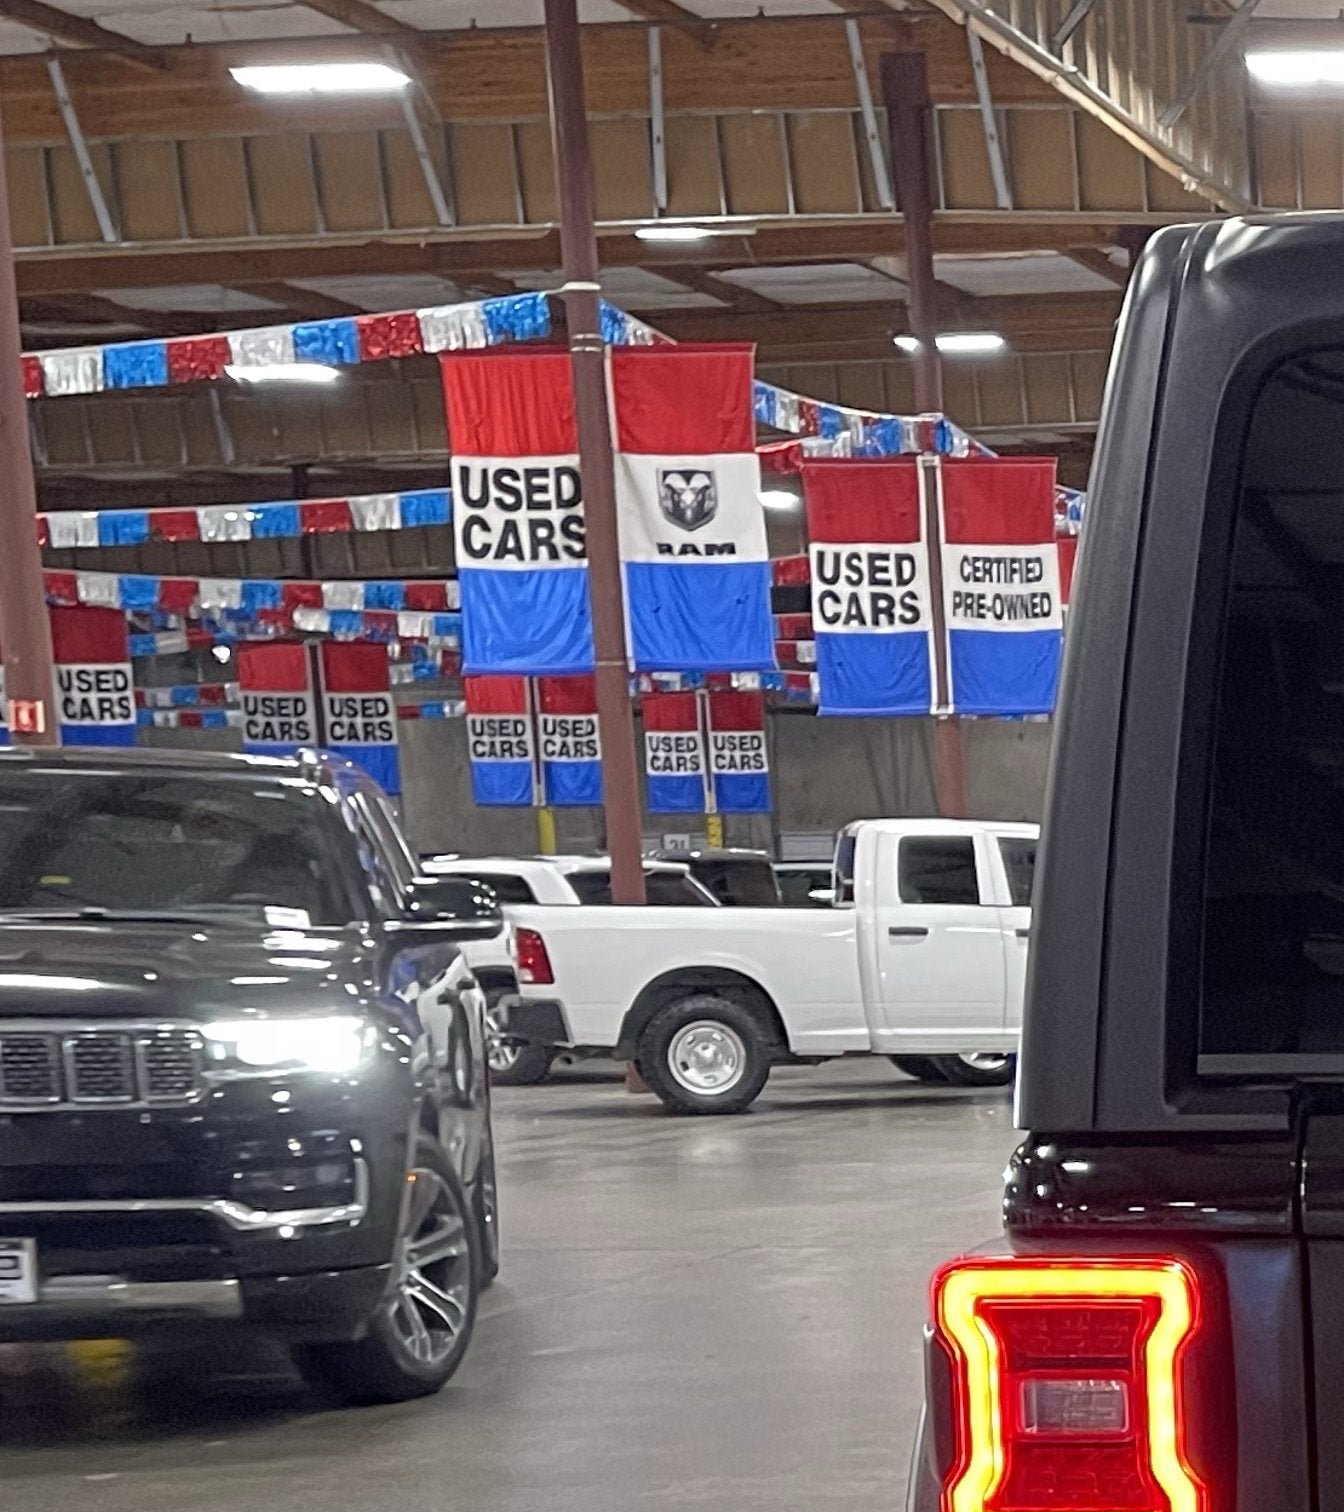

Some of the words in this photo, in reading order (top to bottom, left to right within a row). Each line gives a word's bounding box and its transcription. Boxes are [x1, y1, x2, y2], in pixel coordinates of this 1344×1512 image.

[459, 466, 582, 511] USED
[461, 514, 587, 560] CARS
[656, 542, 736, 556] RAM
[816, 551, 916, 588] USED
[960, 555, 1043, 585] CERTIFIED
[818, 590, 921, 627] CARS
[952, 591, 1052, 620] PRE-OWNED
[58, 669, 128, 693] USED
[63, 697, 131, 721] CARS
[243, 697, 307, 718] USED
[329, 696, 390, 719] USED
[246, 719, 311, 741] CARS
[330, 719, 394, 742] CARS
[471, 719, 526, 737] USED
[543, 719, 596, 737] USED
[472, 740, 529, 759] CARS
[542, 739, 599, 758] CARS
[649, 735, 698, 753] USED
[713, 734, 762, 752] USED
[650, 754, 700, 772] CARS
[714, 753, 765, 771] CARS
